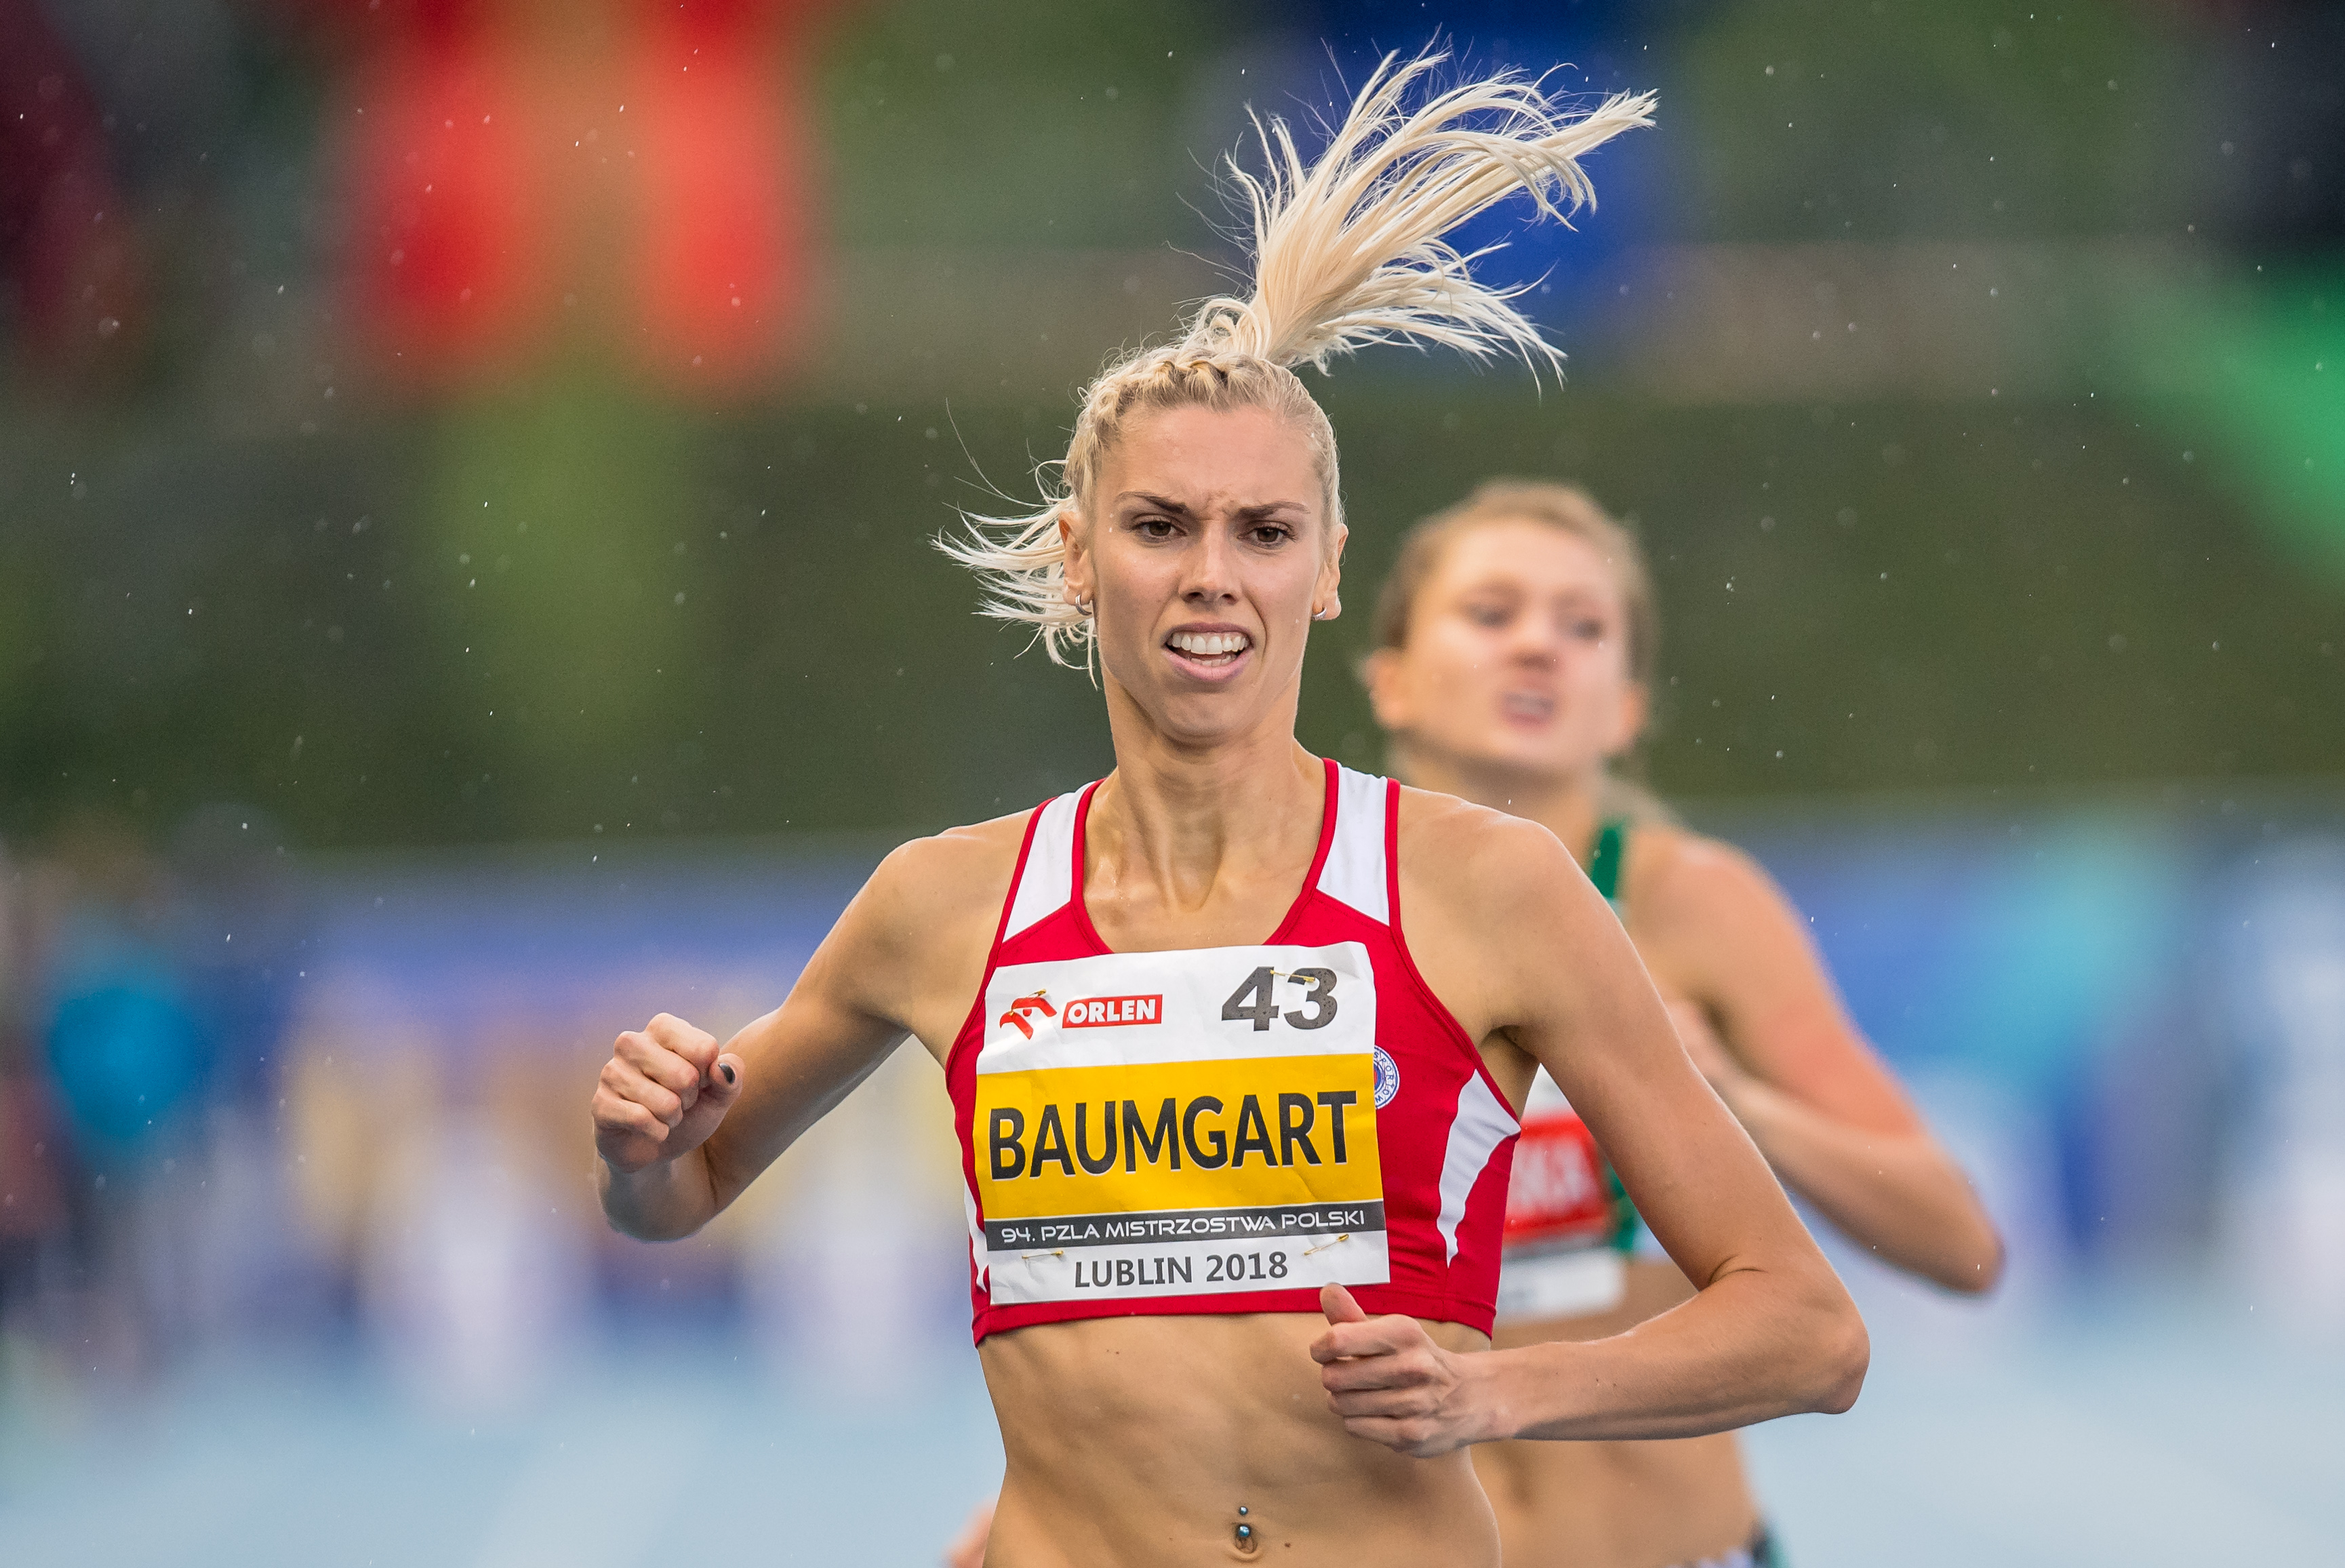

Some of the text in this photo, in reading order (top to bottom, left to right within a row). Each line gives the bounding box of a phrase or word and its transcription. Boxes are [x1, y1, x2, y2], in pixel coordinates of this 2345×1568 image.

[1068, 999, 1156, 1024] ORLEN
[1222, 966, 1338, 1032] 43
[989, 1091, 1357, 1181] BAUMGART
[1001, 1210, 1365, 1243] 94. PZLA MISTRZOSTWA POLSKI
[1075, 1251, 1288, 1287] LUBLIN 2018
